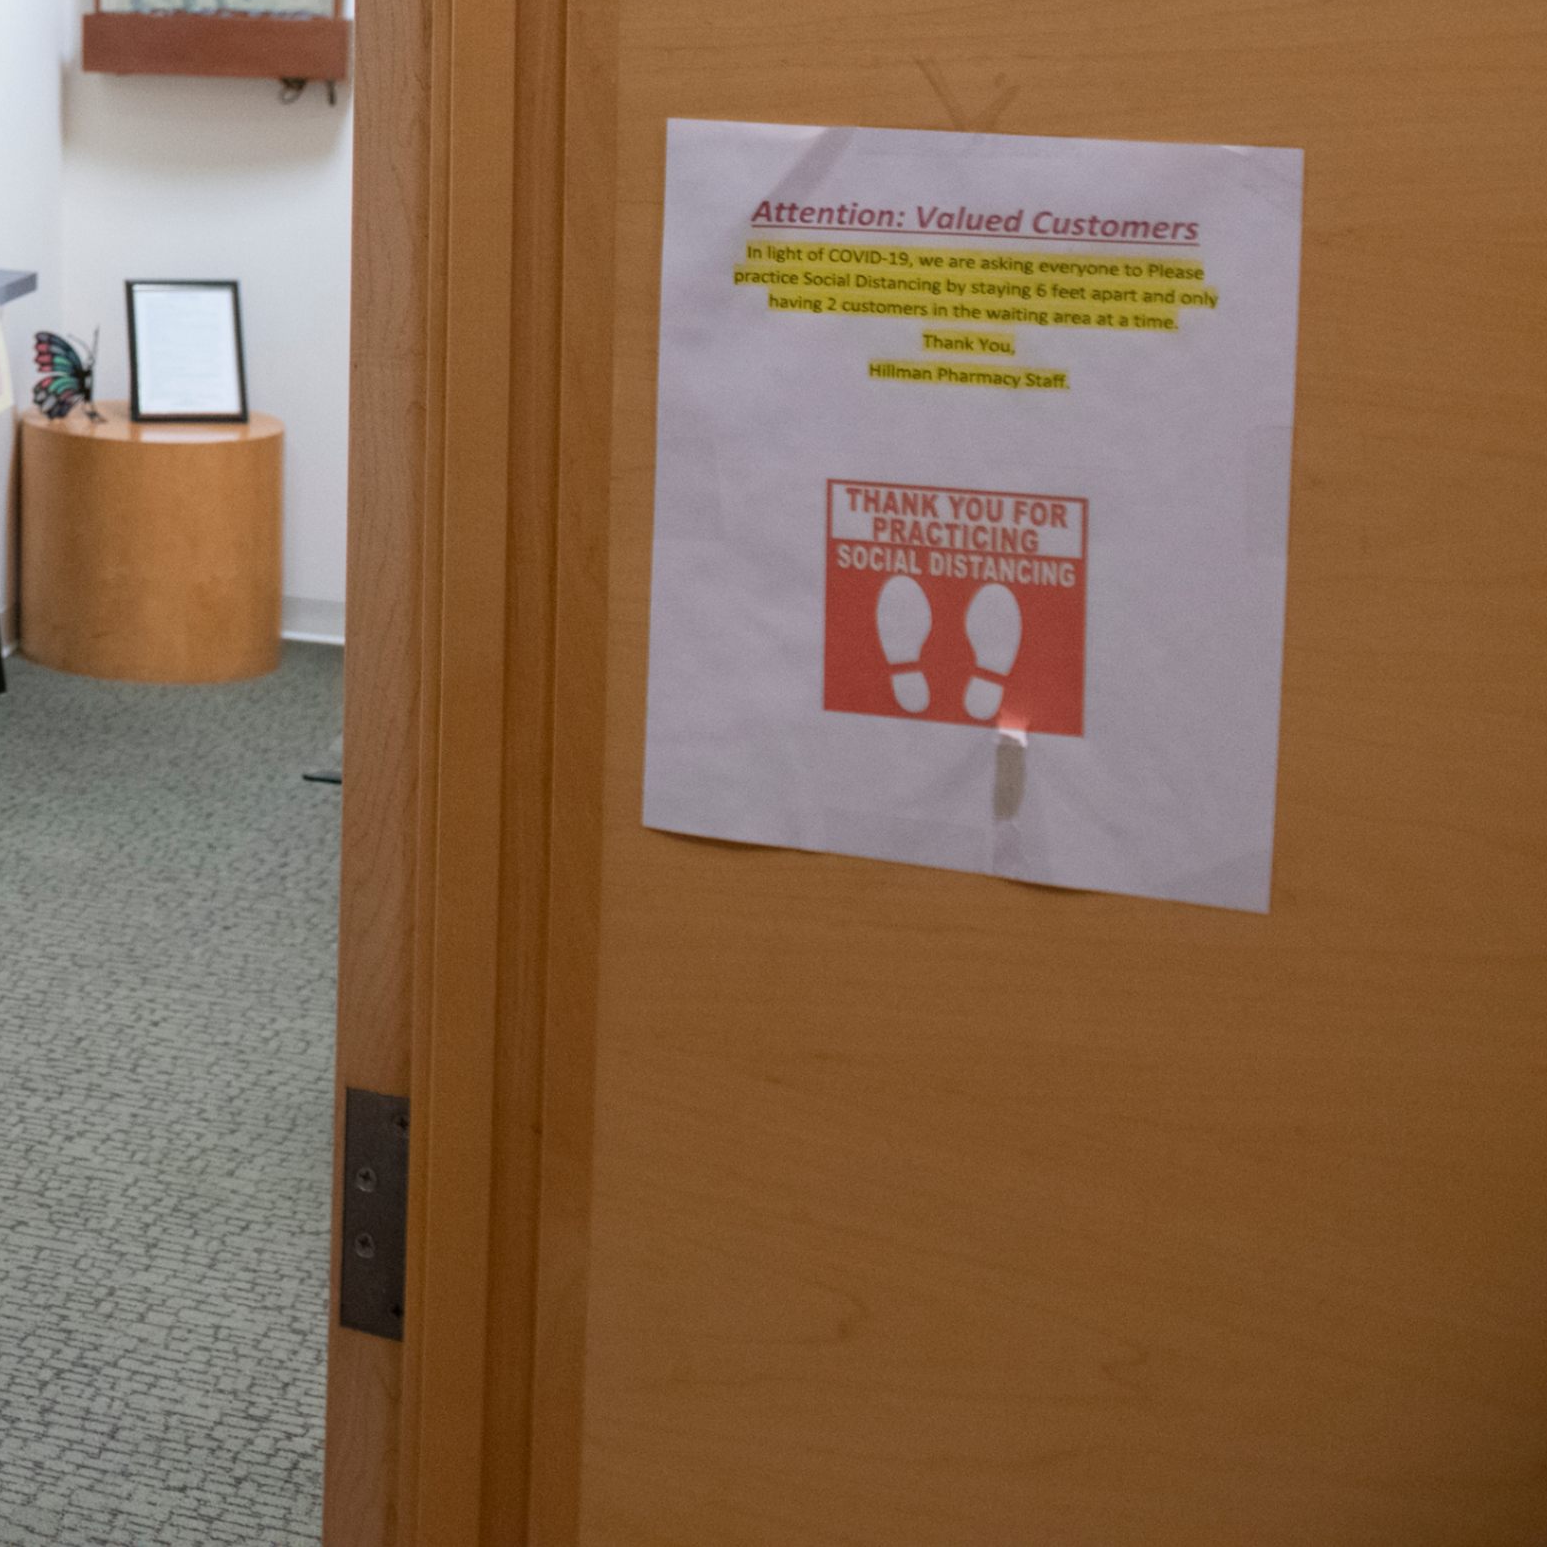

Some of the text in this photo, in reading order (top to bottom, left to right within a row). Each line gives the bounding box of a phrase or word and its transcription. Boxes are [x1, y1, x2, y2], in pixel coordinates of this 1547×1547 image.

[751, 200, 1200, 241] Attention: Valued Customers
[747, 245, 1204, 280] In light of COVID-19, we are asking everyone to Please
[734, 271, 1218, 308] practice Social Distancing by staying 6 feet apart and only
[769, 294, 1179, 330] having 2 customers in the waiting area at a time.
[923, 334, 974, 350] Thank
[869, 364, 1070, 389] Hillman Pharmacy Staff.
[846, 488, 1068, 528] THANK YOU FOR
[874, 517, 1039, 553] PRACTICING
[838, 545, 1076, 587] SOCIAL DISTANCING
